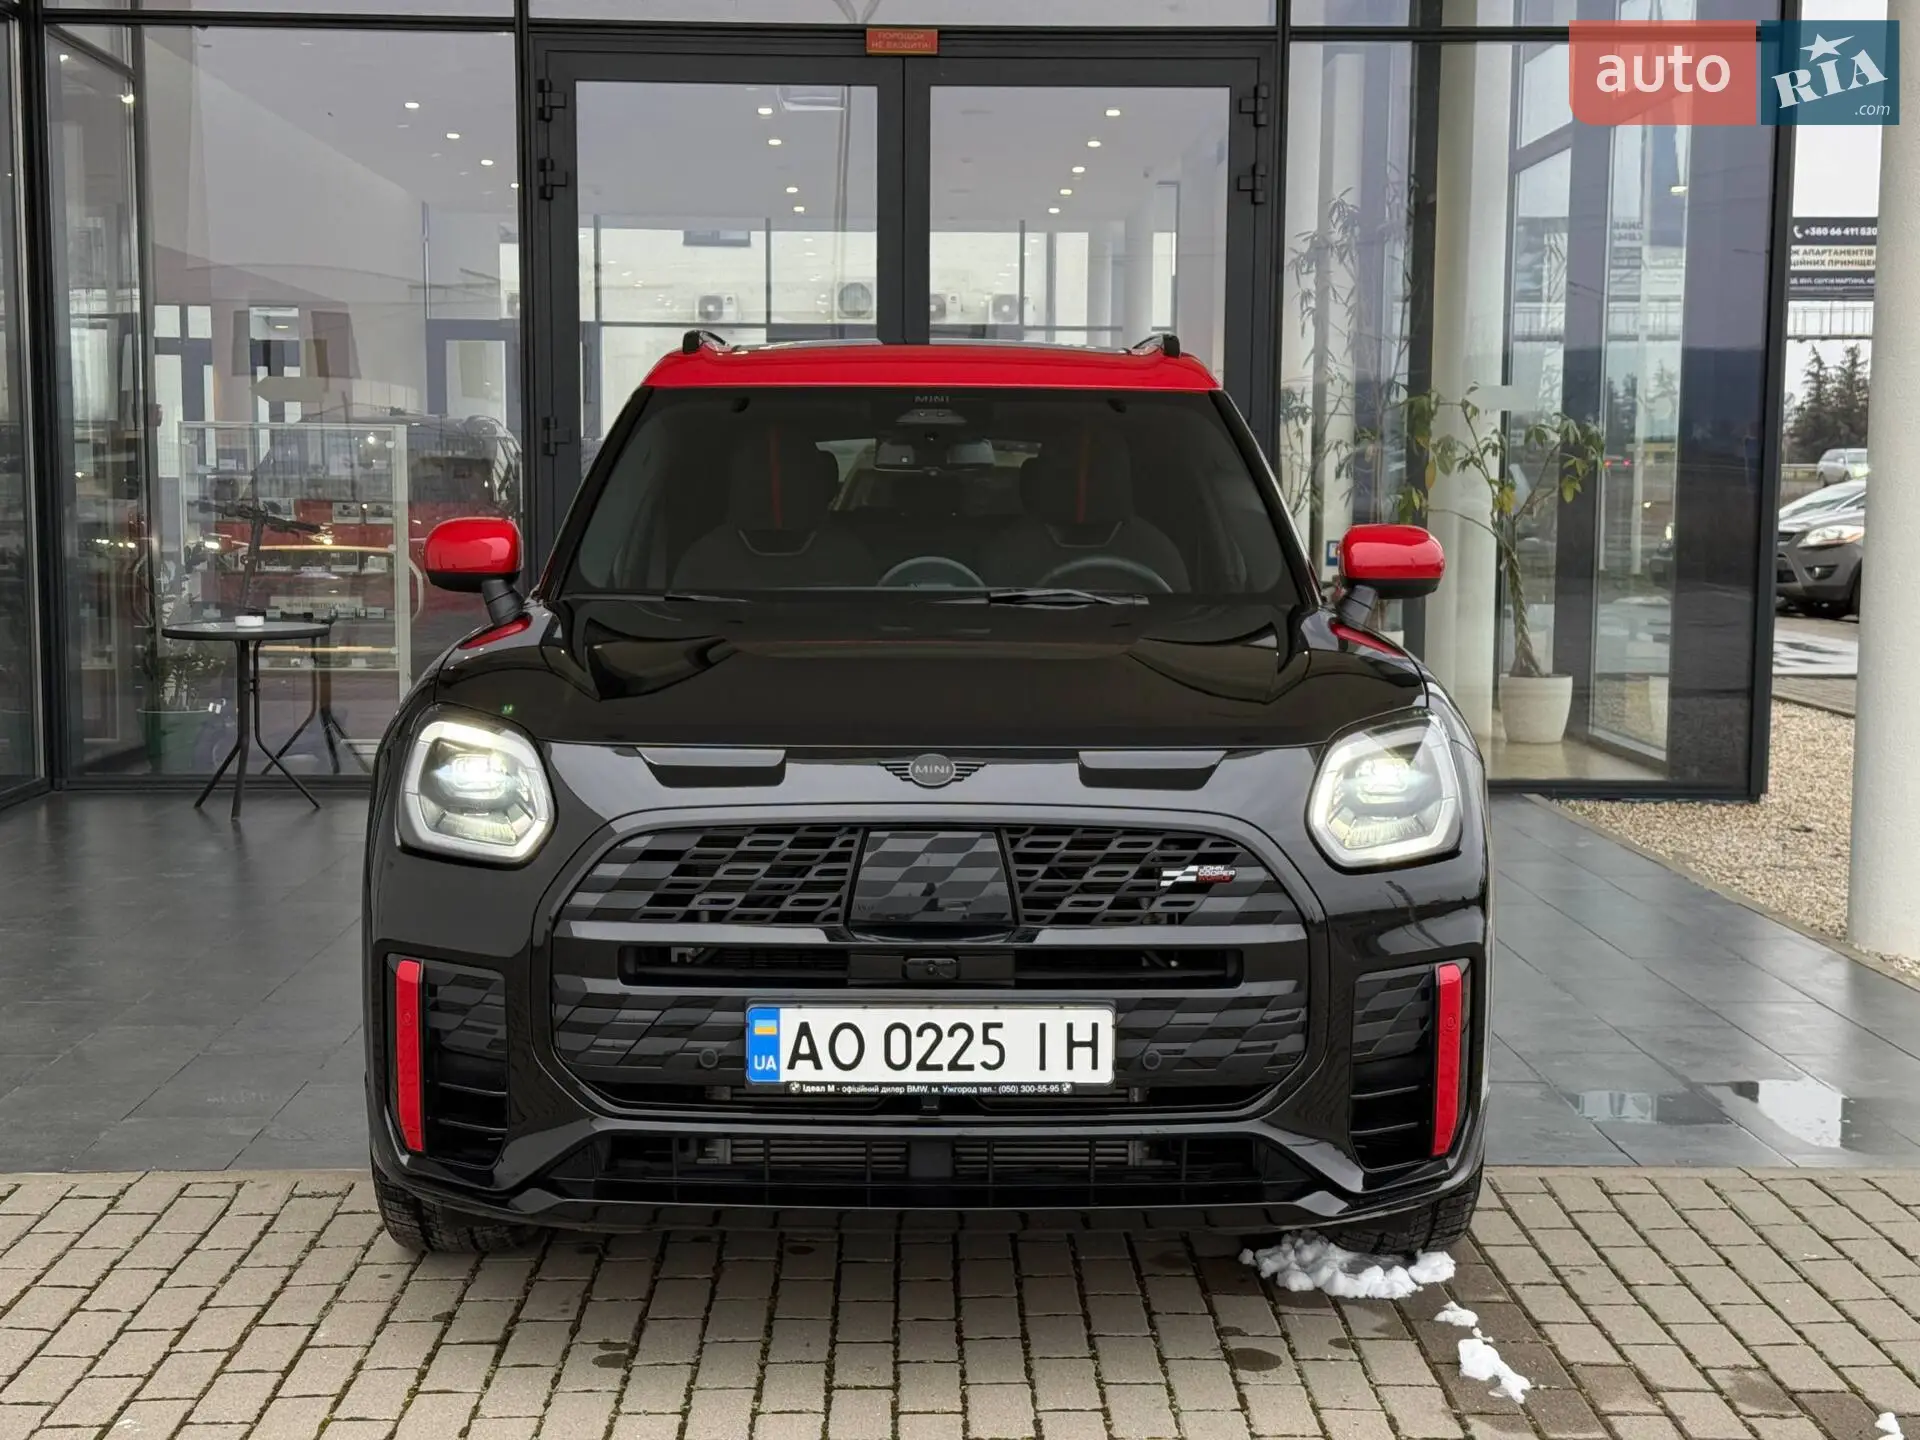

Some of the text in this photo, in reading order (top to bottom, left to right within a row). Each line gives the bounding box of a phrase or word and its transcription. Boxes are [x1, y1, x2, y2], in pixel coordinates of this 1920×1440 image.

[871, 40, 884, 49] НЕ
[1804, 227, 1828, 236] +380
[1829, 227, 1842, 236] 66
[1843, 227, 1859, 236] 411
[1802, 248, 1874, 257] АПАРТАМЕНТІВ
[1791, 259, 1826, 268] ЦІЙНИХ
[914, 395, 950, 403] MINI
[915, 764, 951, 774] MINI
[786, 1022, 866, 1071] AO
[884, 1022, 1006, 1071] 0225
[754, 1055, 778, 1071] UA
[802, 1084, 826, 1093] Ідеал
[841, 1084, 880, 1095] офіційний
[880, 1085, 905, 1095] дилер
[942, 1084, 978, 1095] Ужгород
[998, 1084, 1019, 1095] (050)
[1020, 1084, 1060, 1093] 300-55-95
